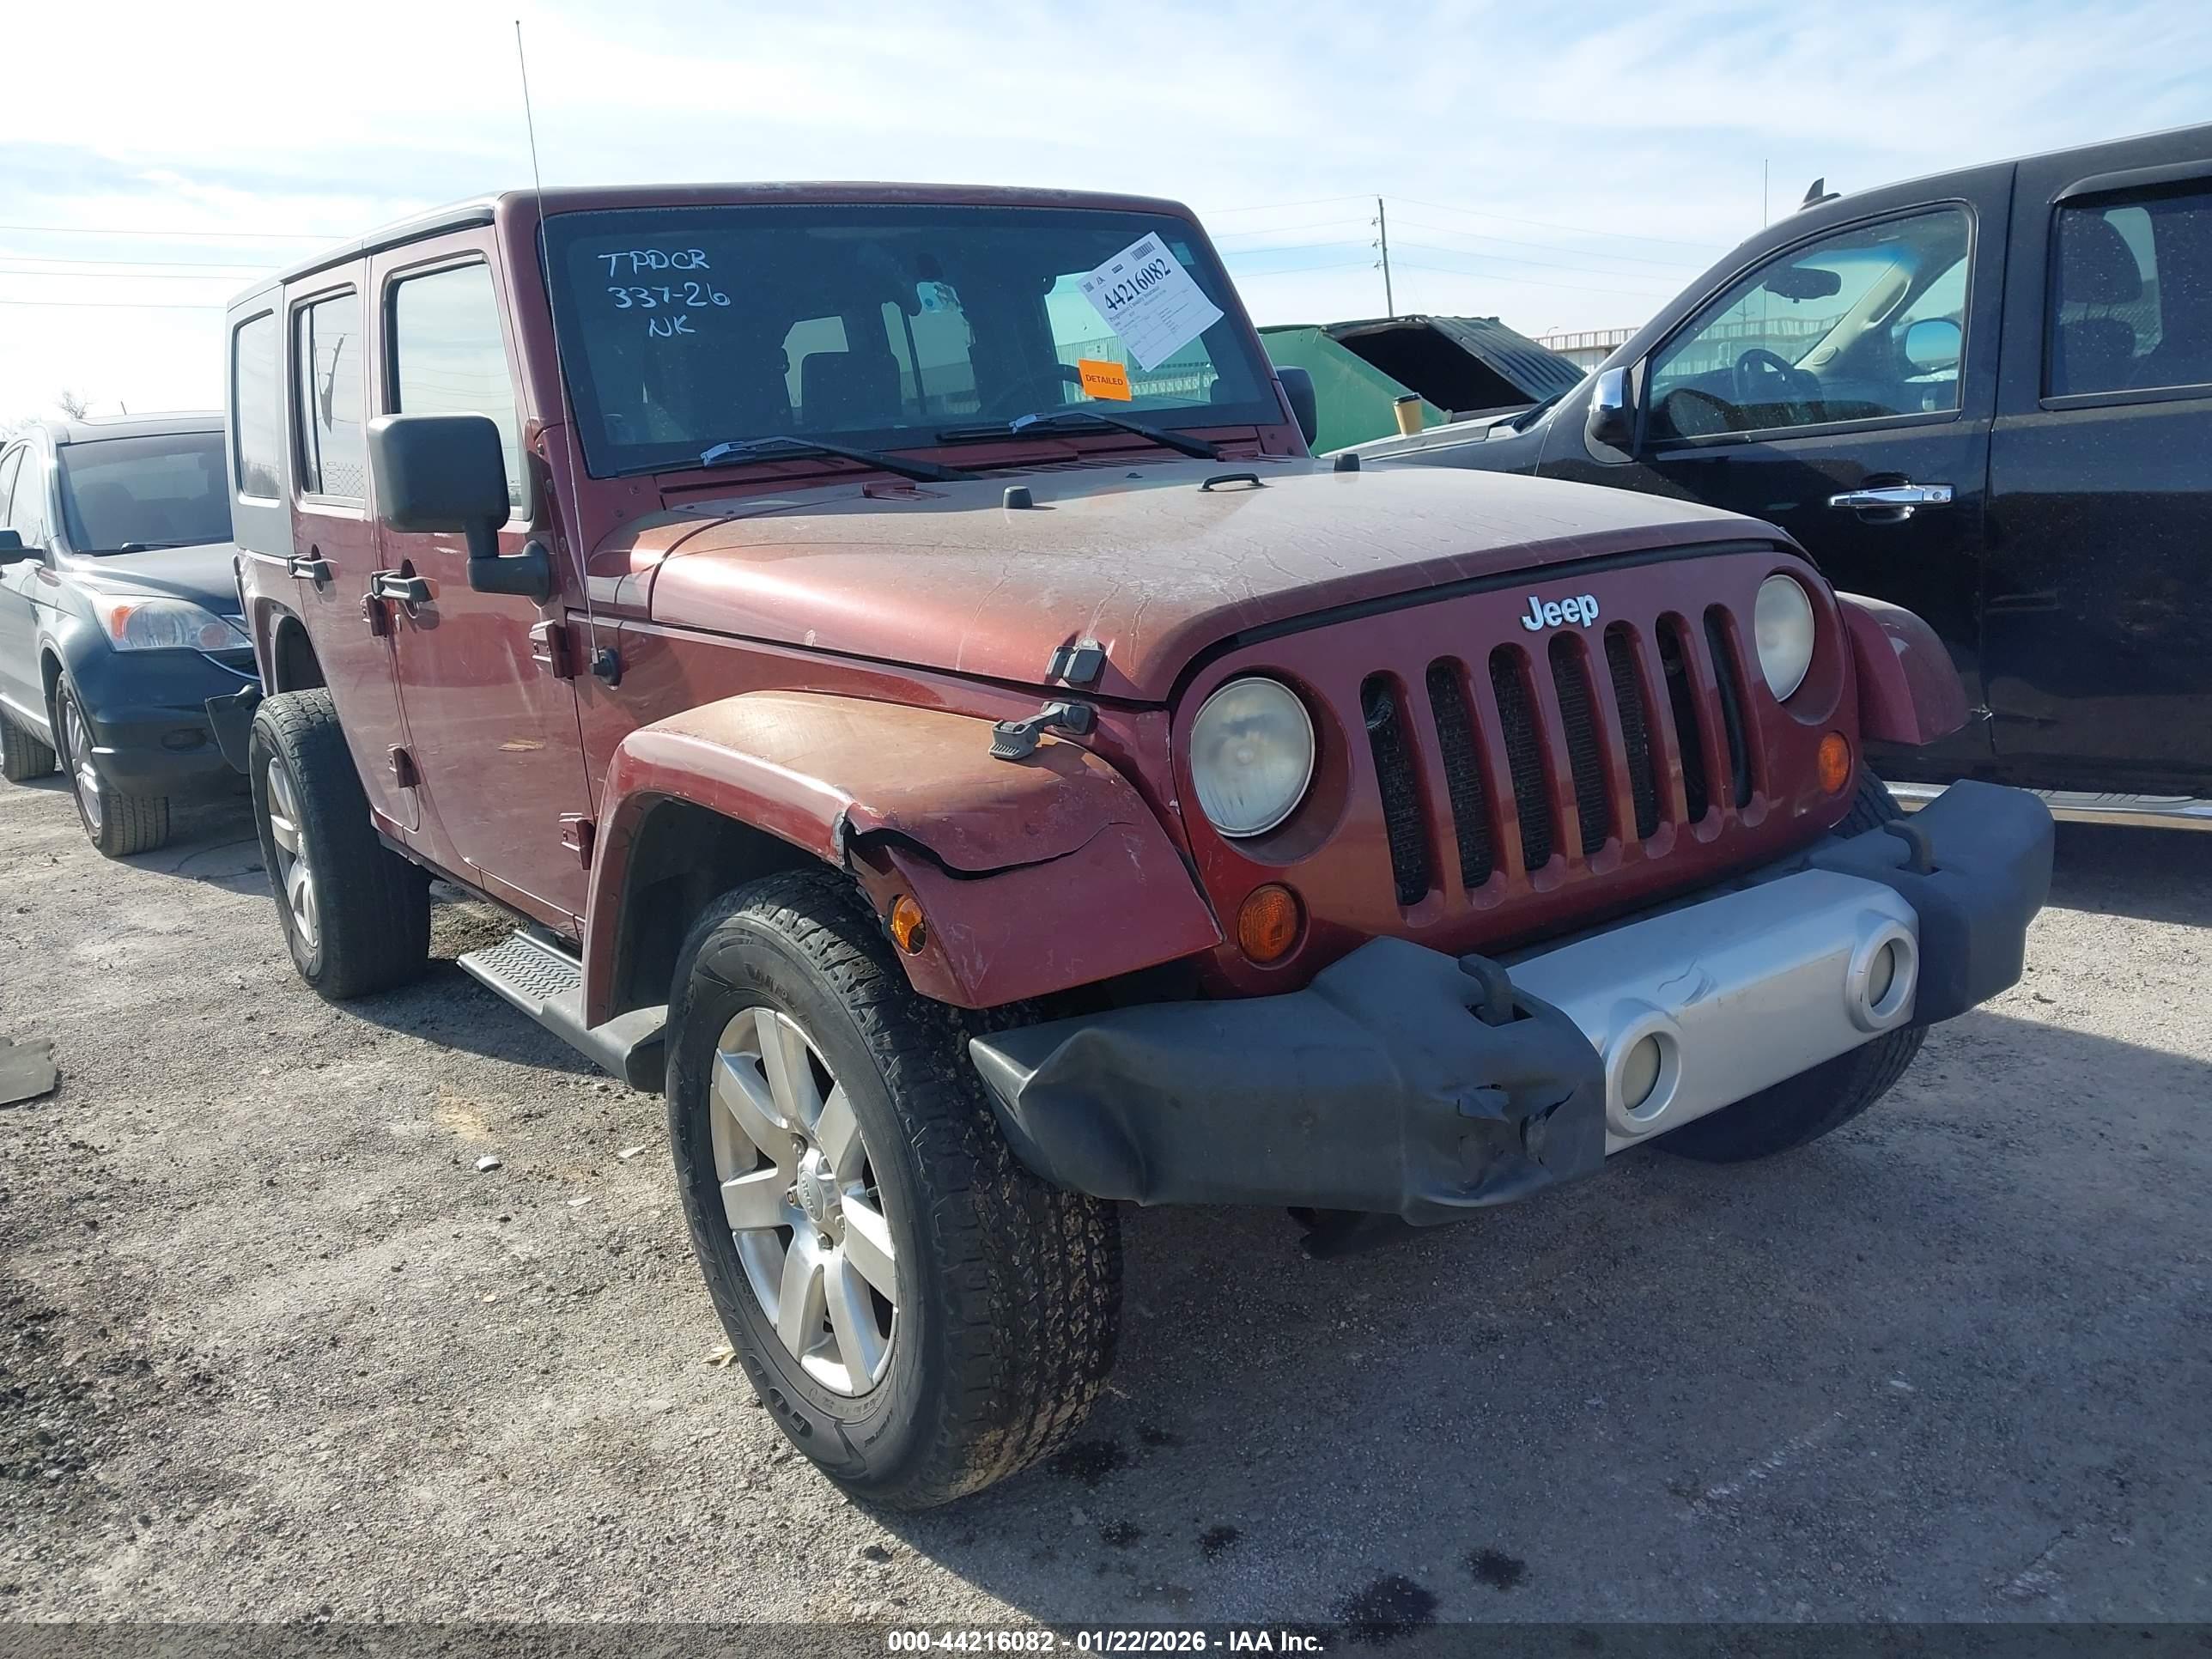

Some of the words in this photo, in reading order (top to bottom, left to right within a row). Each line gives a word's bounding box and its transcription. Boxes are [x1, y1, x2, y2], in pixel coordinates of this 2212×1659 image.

[598, 249, 709, 277] TPDCR
[607, 282, 731, 308] 337-26
[1103, 258, 1171, 309] 44216082
[648, 315, 696, 337] NK
[1085, 374, 1123, 386] DETAILED
[1521, 594, 1599, 631] Jeep
